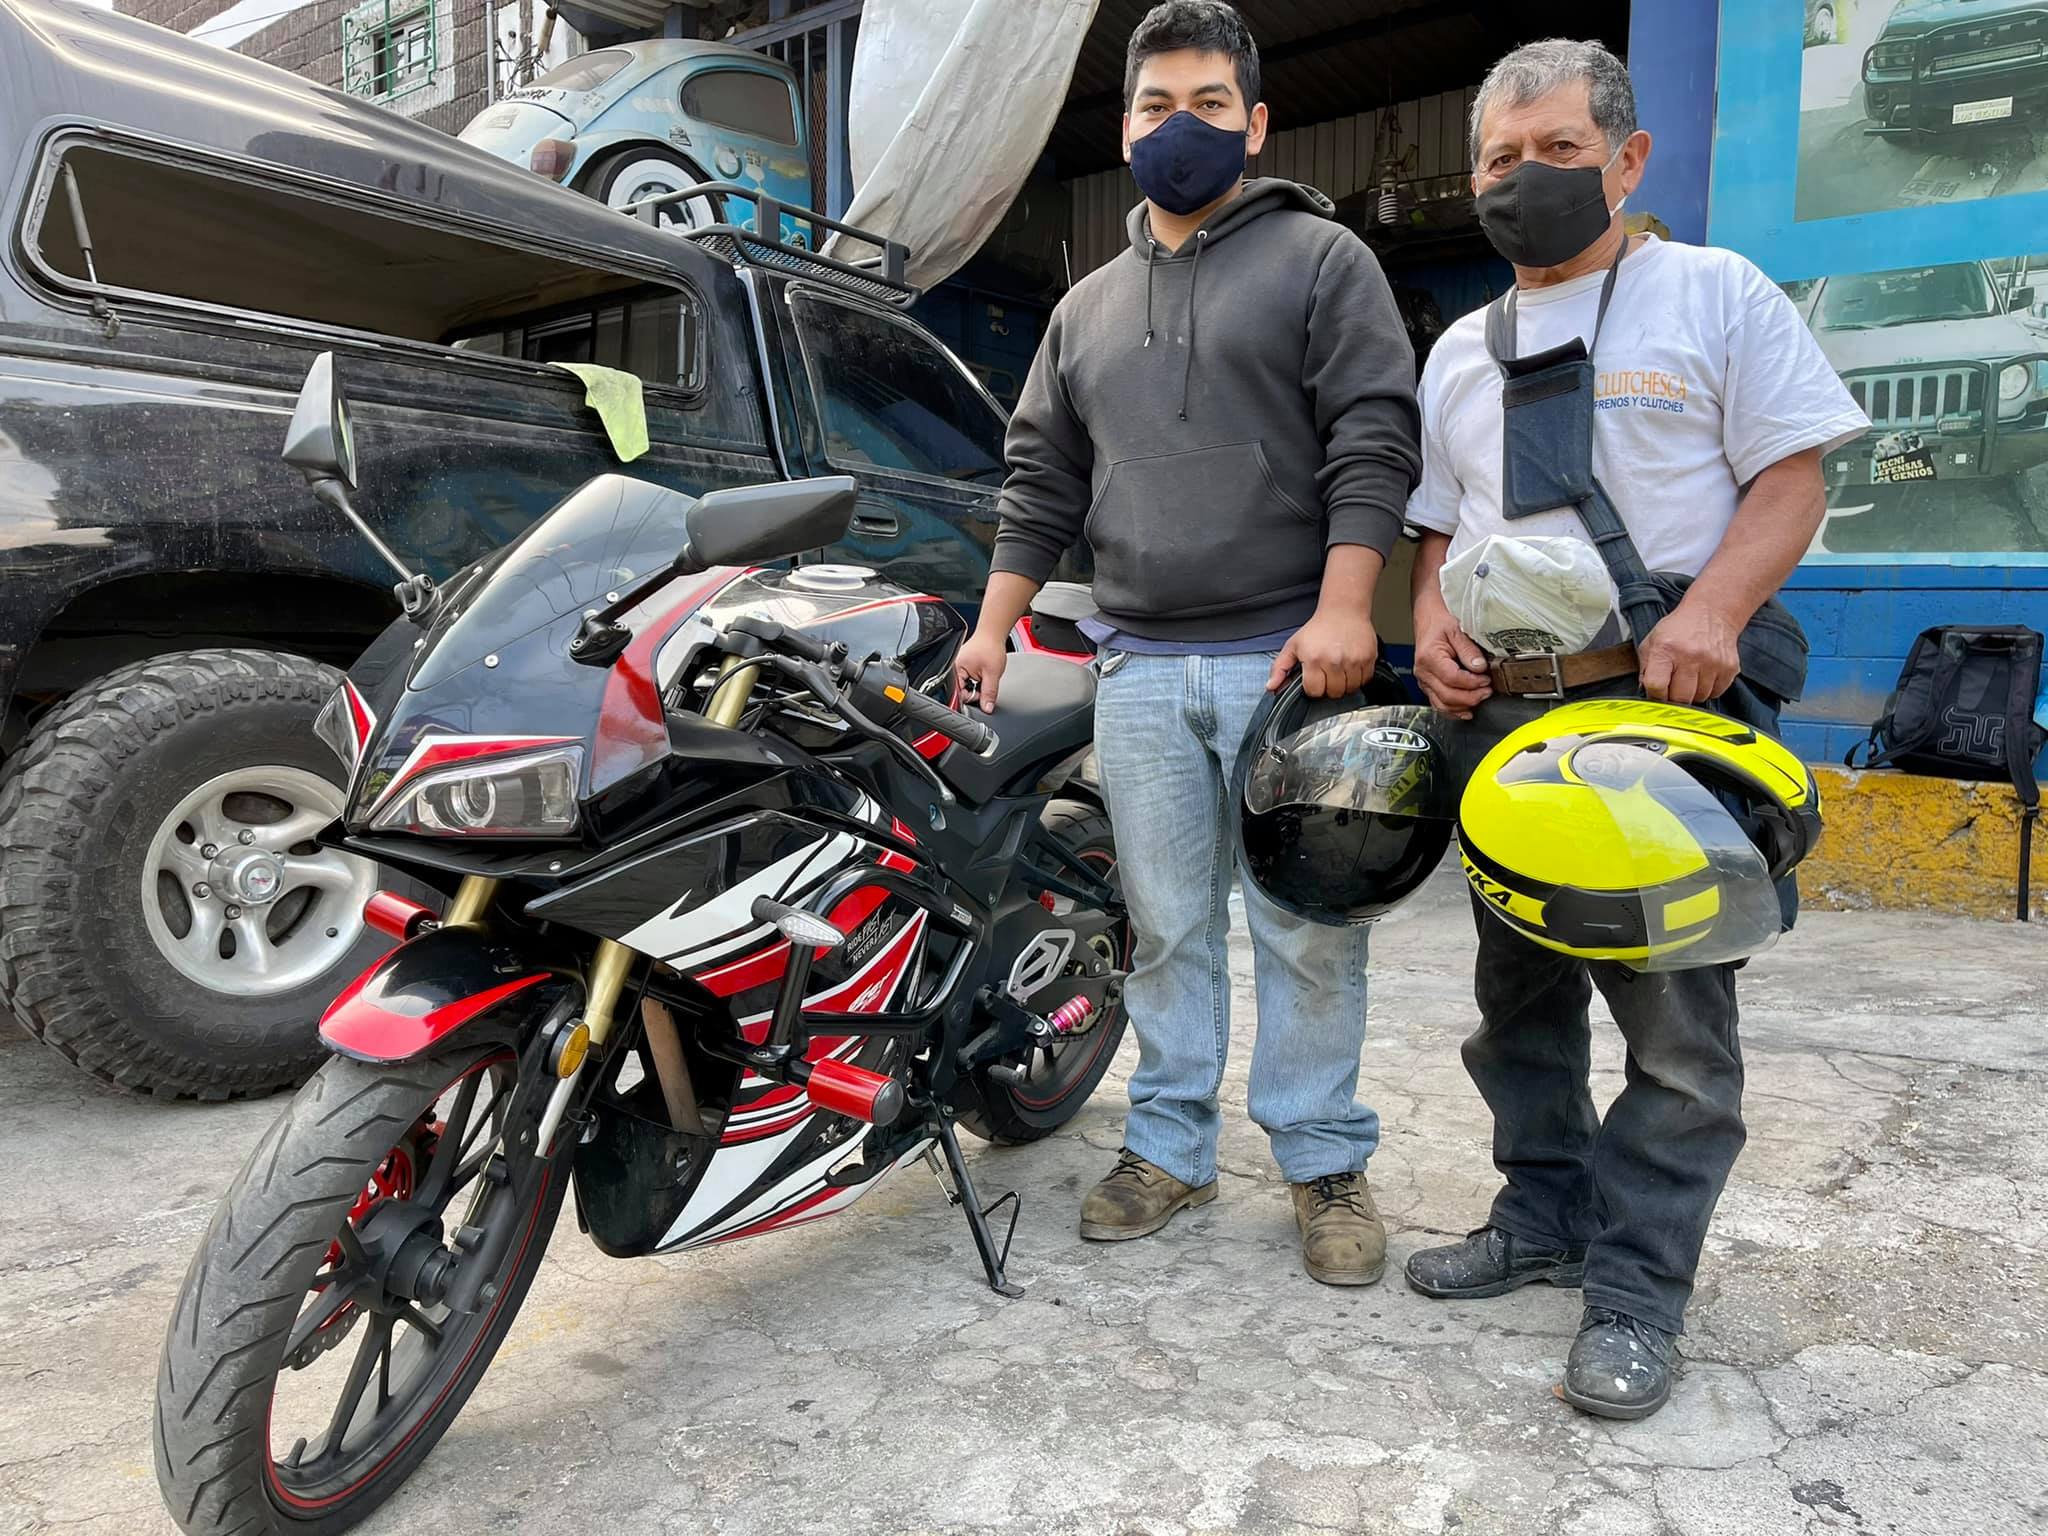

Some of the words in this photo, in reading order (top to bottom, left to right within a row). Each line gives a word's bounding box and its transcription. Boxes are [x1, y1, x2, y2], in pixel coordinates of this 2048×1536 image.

[1595, 369, 1687, 400] CLUTCHESCA
[1594, 398, 1630, 411] FRENOS
[1632, 396, 1639, 407] Y
[1640, 397, 1684, 413] CLUTCHES
[1877, 456, 1905, 470] TECNI
[1892, 466, 1934, 481] GENIOS
[853, 934, 875, 963] NEVER
